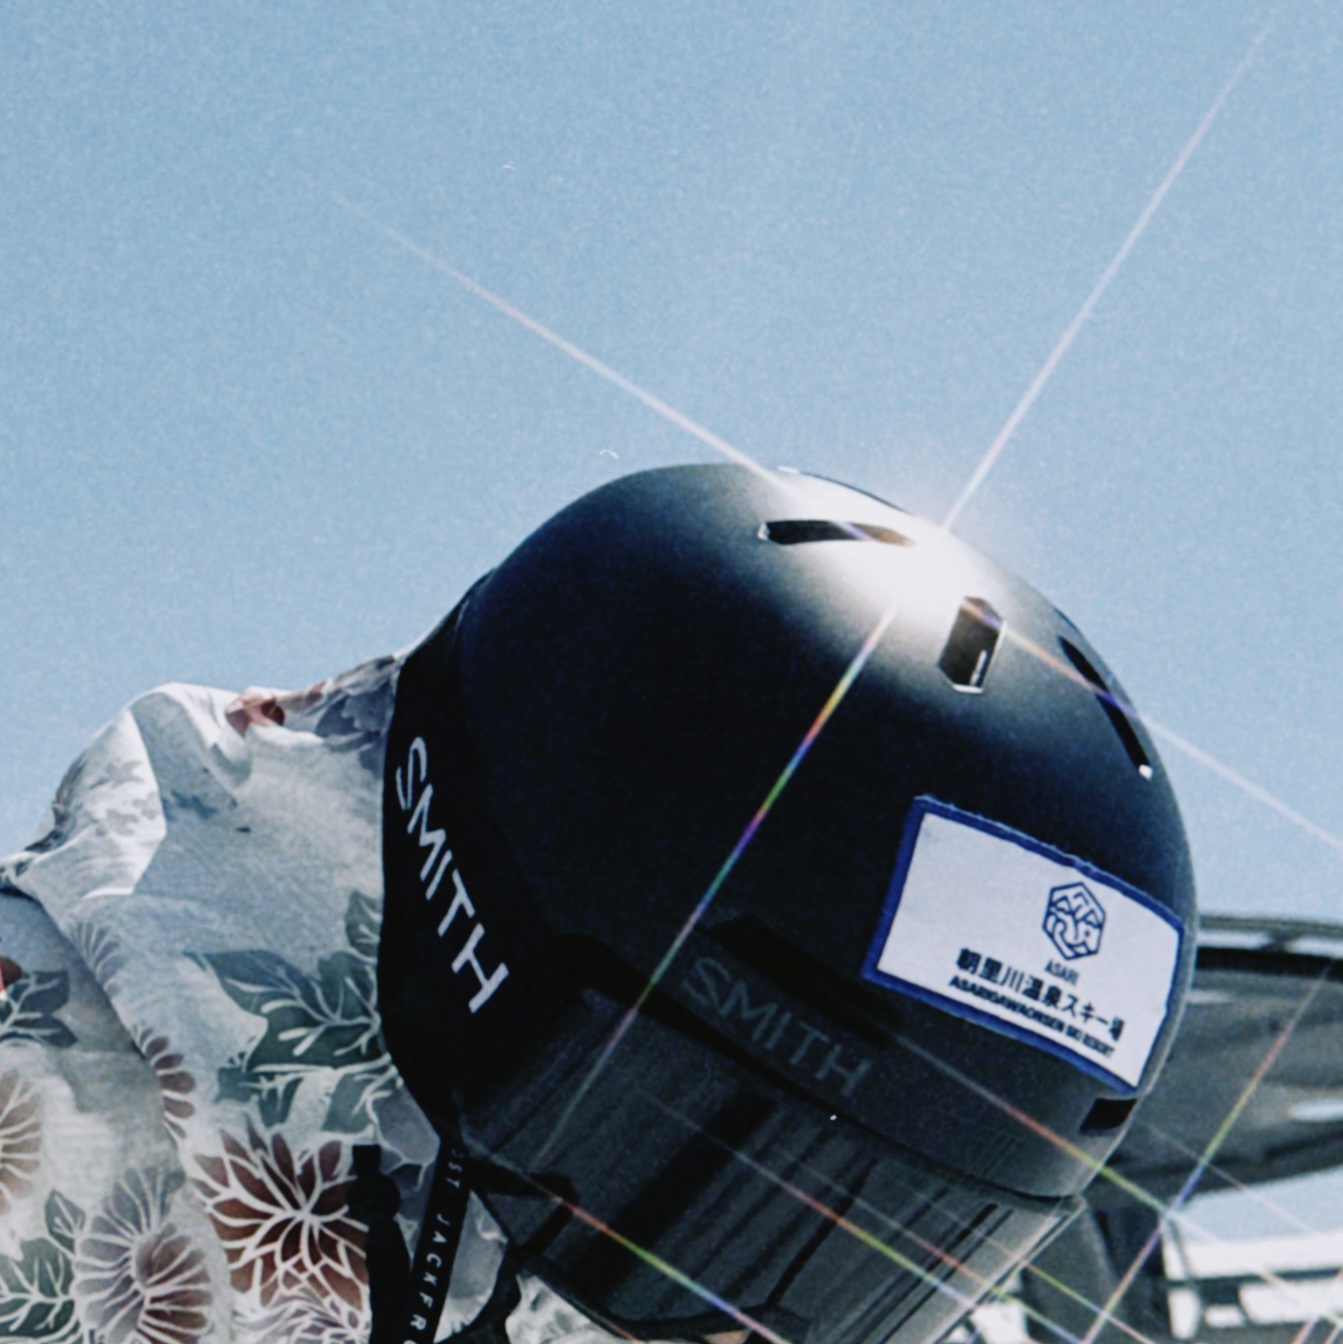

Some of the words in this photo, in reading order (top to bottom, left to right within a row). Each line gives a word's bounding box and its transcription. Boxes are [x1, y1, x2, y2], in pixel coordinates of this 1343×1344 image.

[397, 736, 509, 1013] SMITH
[682, 957, 871, 1096] SMITH
[956, 947, 1125, 1042] 朝里川温泉スキー場
[1045, 960, 1078, 985] ASARI
